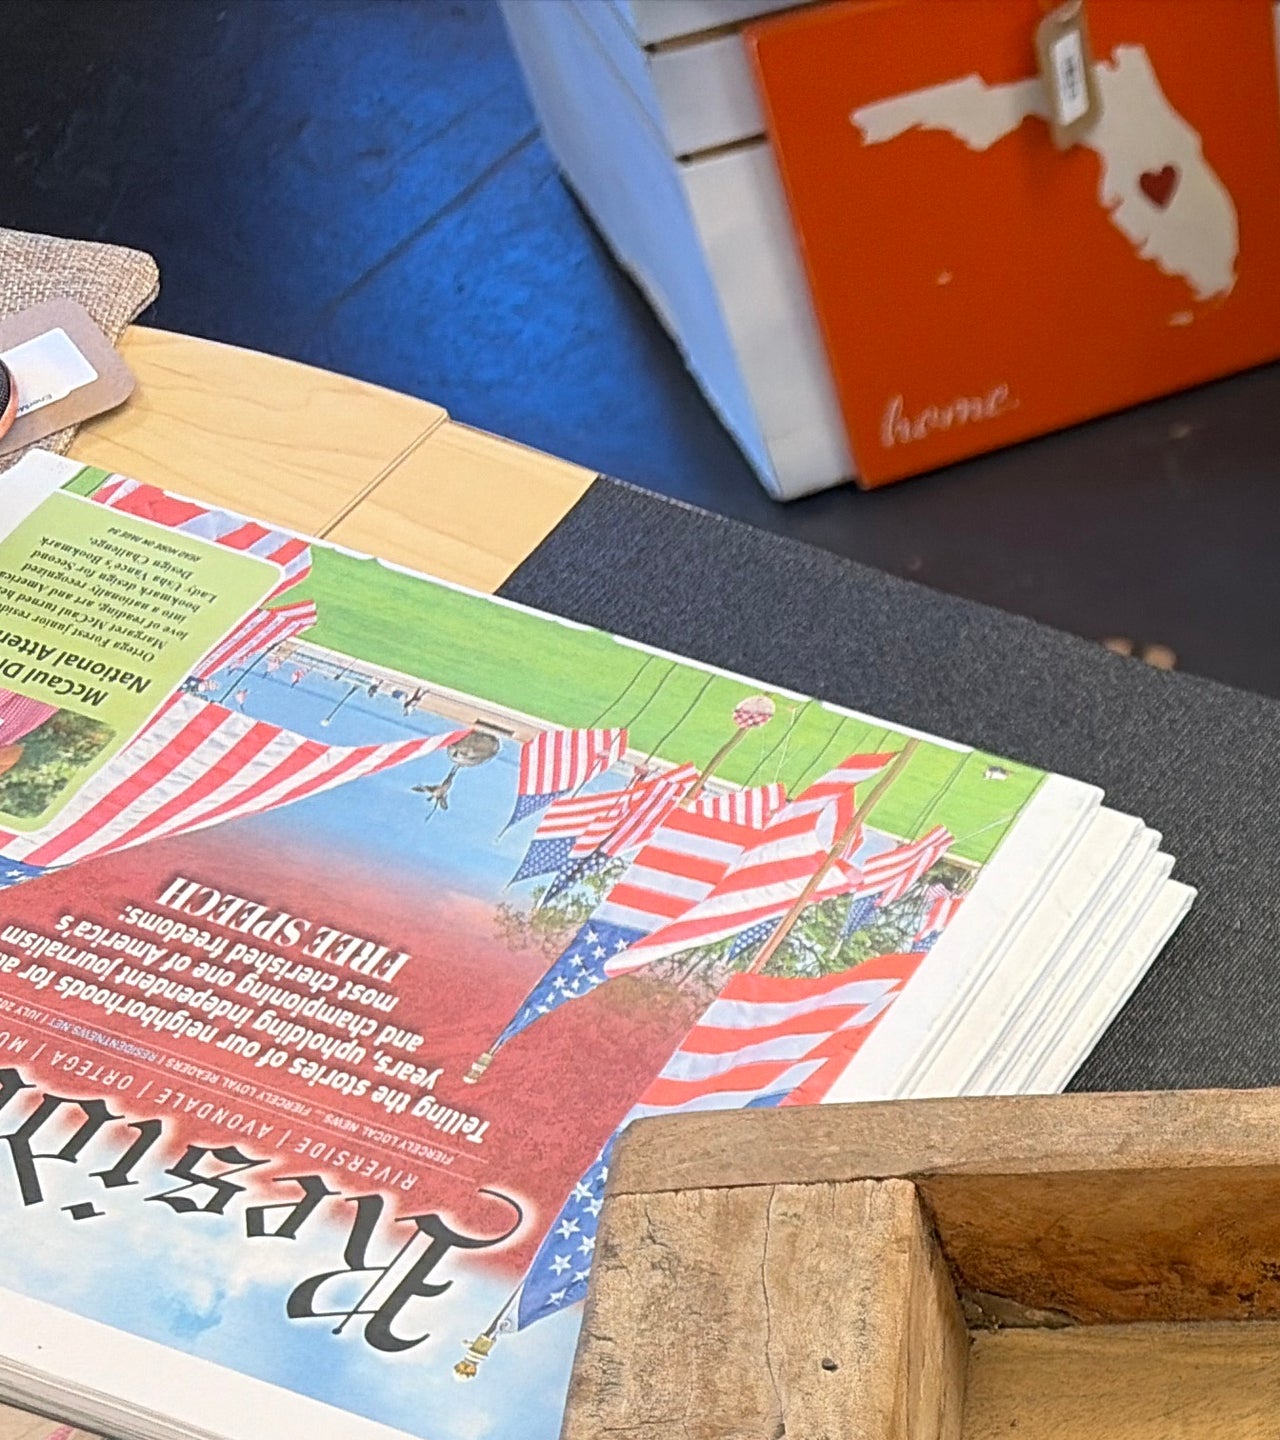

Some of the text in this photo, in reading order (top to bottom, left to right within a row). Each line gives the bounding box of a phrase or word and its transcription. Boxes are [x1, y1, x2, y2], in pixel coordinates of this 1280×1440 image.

[881, 385, 1020, 447] home
[20, 562, 88, 589] recognized
[40, 536, 217, 603] Lady Usha Vance's Bookmark
[89, 537, 194, 580] Design Challenge.
[29, 549, 201, 613] bookmark design for Second
[89, 584, 150, 610] nationally
[0, 571, 189, 641] love of reading, art and America
[14, 593, 58, 613] turned
[56, 606, 108, 630] McCaul
[161, 610, 187, 625] into
[0, 604, 155, 662] Ortega Forest junior resid
[108, 623, 168, 650] Margaret
[20, 668, 109, 707] McCaul
[51, 651, 152, 694] National
[154, 877, 412, 983] FREE SPEECH
[117, 905, 400, 1013] most cherished freedoms:
[55, 915, 424, 1053] and championing one of America's
[0, 925, 444, 1090] years, upholding independent journalism
[13, 1005, 43, 1021] JULY
[0, 953, 490, 1143] Telling the stories of our neighborhoods for al
[50, 1050, 134, 1090] ORTEGA
[164, 1057, 221, 1084] READERS
[222, 1077, 257, 1097] LOYAL
[153, 1087, 274, 1139] AVONDALE
[255, 1091, 313, 1116] FIERCELY
[362, 1125, 400, 1147] LOCAL
[397, 1139, 455, 1165] FIERCELY
[293, 1136, 419, 1191] RIVERSIDE
